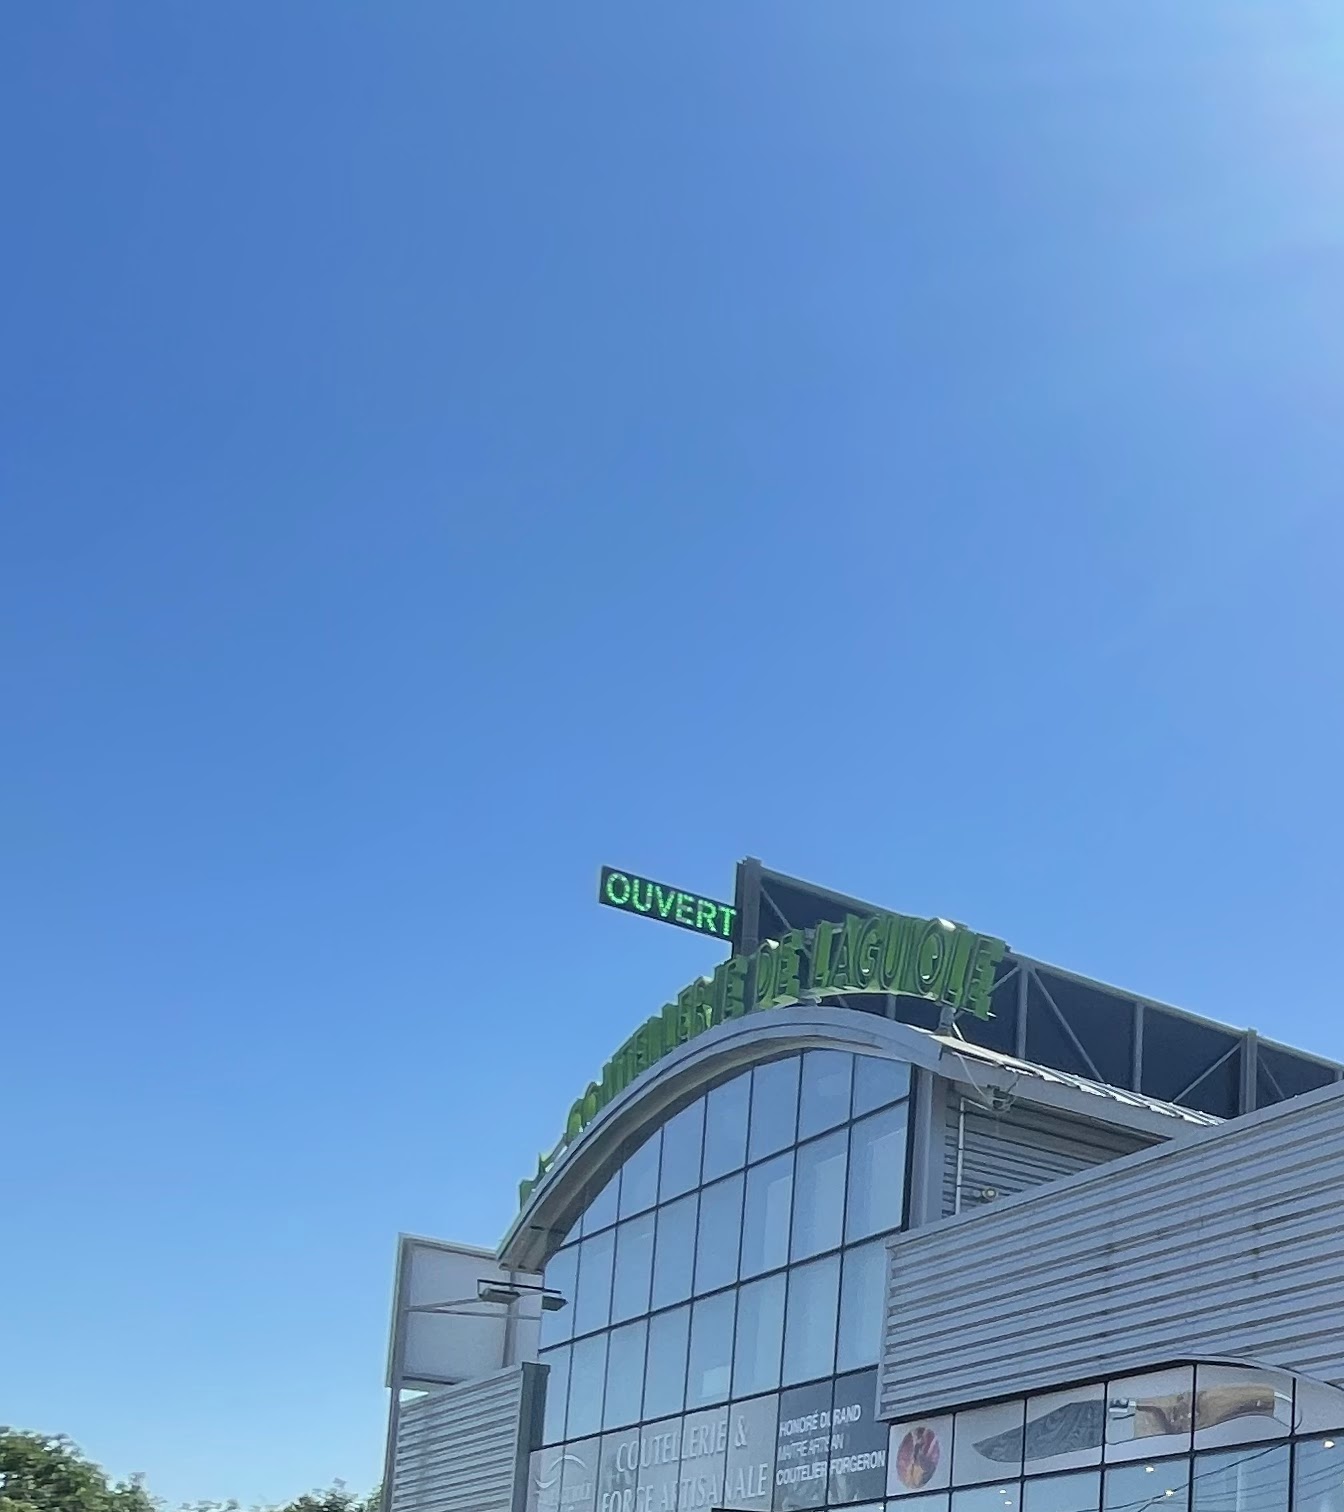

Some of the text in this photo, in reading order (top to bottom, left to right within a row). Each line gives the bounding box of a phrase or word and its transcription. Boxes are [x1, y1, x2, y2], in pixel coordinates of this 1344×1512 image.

[606, 872, 737, 936] OUVERT
[810, 914, 1006, 1021] LAGUIOLE
[616, 1415, 748, 1473] COUTELLERIE &
[775, 1450, 886, 1486] COUTELIER FORGERON
